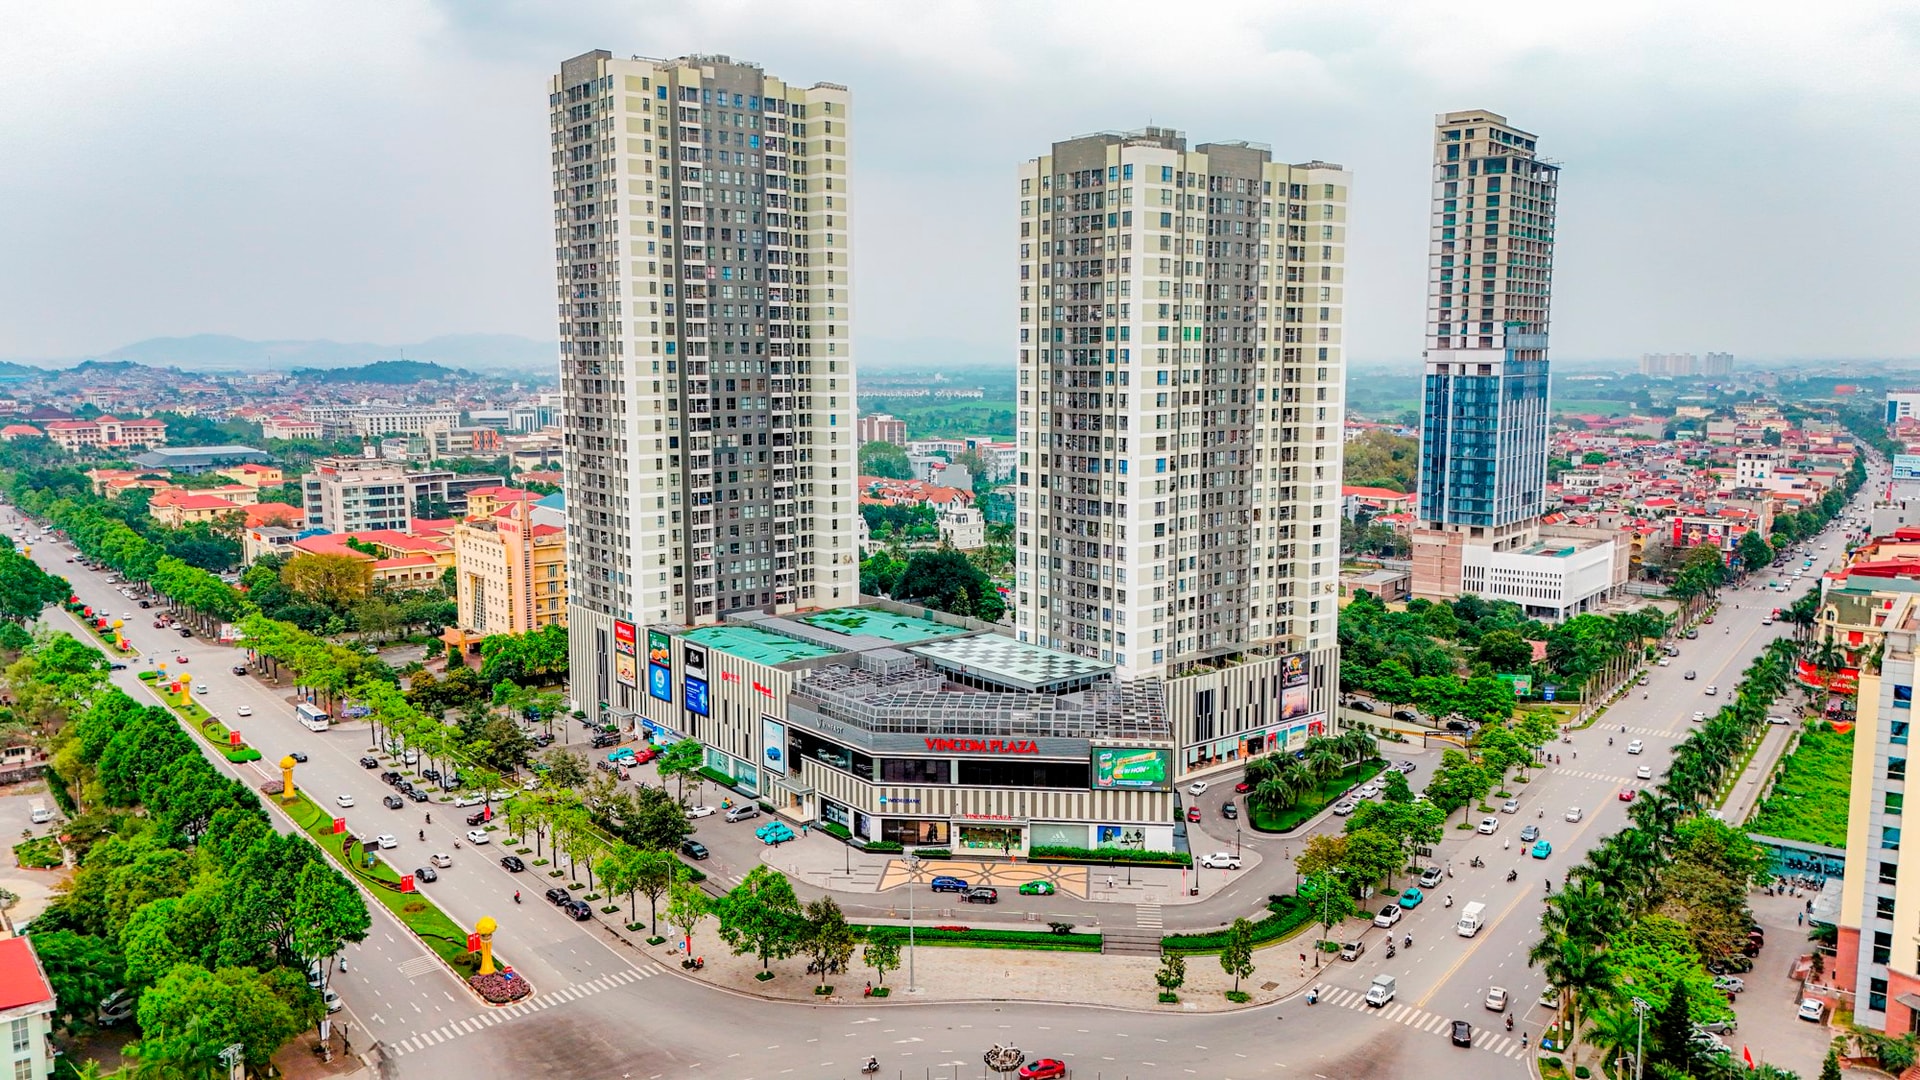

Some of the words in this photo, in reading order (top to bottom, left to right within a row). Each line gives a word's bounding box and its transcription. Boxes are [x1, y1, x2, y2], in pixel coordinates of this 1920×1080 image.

[843, 555, 854, 564] SA
[1325, 584, 1335, 593] SC
[924, 738, 987, 753] VINCOM
[989, 739, 1039, 755] PLAZA
